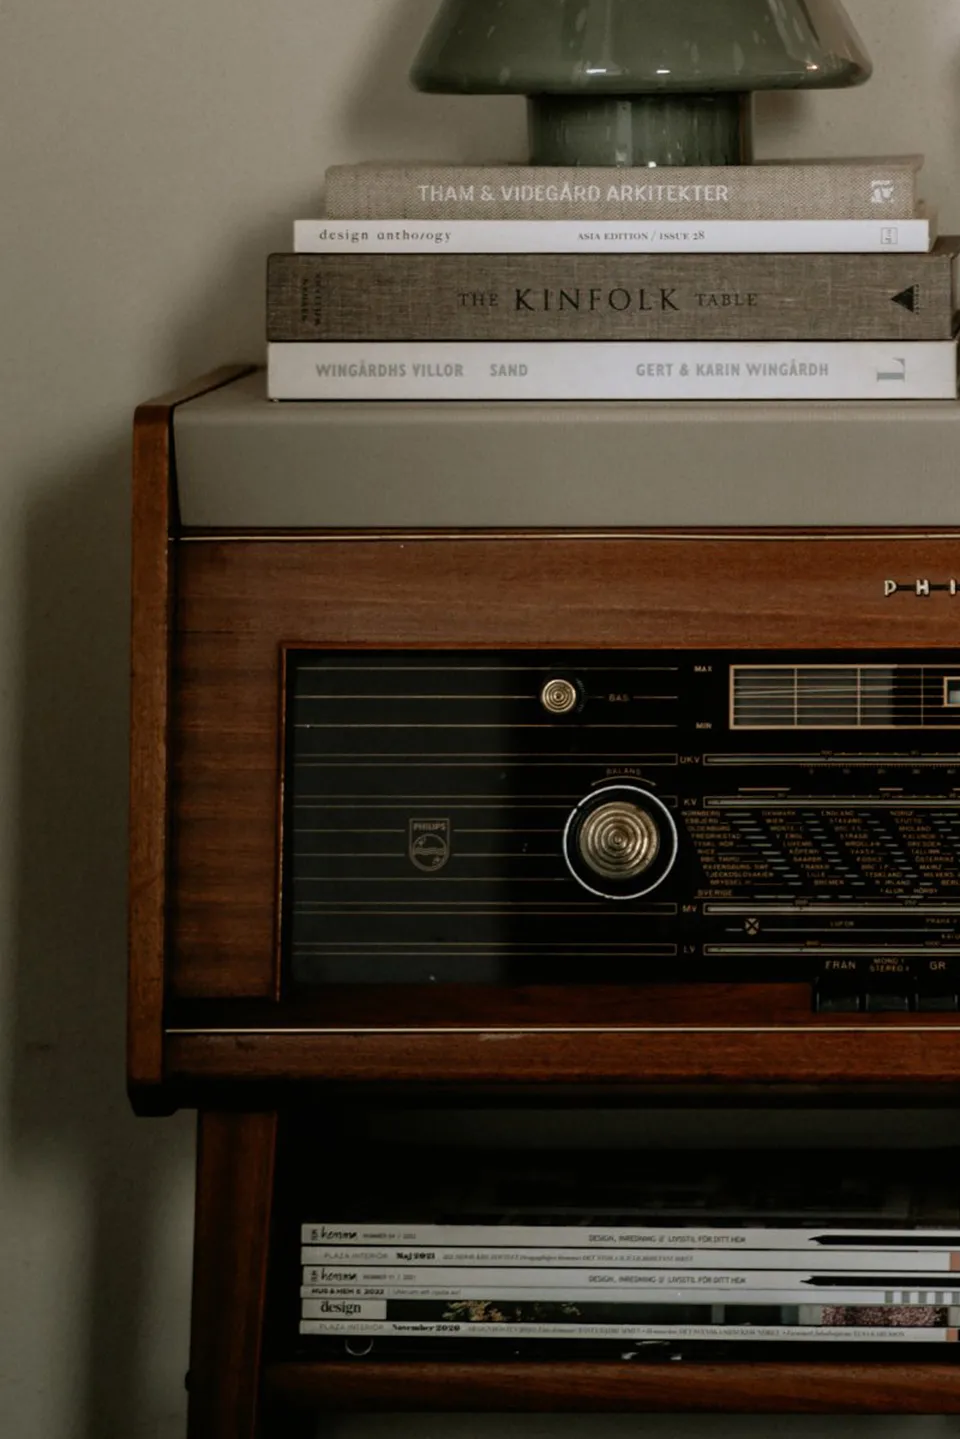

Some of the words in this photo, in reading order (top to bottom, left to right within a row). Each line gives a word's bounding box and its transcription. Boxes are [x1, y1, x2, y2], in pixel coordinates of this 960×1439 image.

[418, 185, 474, 202] THAM
[480, 185, 495, 201] &
[501, 182, 601, 202] VIDEGÅRD
[606, 185, 730, 202] ARKITEKTER
[319, 229, 369, 242] design
[577, 232, 601, 241] ASIA
[604, 232, 649, 241] EDITION
[659, 232, 690, 241] ISSUE
[692, 231, 706, 242] 28
[457, 291, 500, 307] THE
[515, 287, 681, 311] KINFOLK
[695, 292, 758, 308] TABLE
[316, 359, 407, 377] WINGÅRDHS
[412, 364, 464, 377] VILLOR
[489, 364, 528, 377] SAND
[636, 363, 673, 377] GERT
[679, 363, 690, 377] &
[696, 363, 741, 377] KARIN
[745, 359, 830, 377] WINGÅRDH
[680, 755, 700, 764] UKV
[683, 798, 697, 806] KV
[683, 904, 697, 913] MV
[684, 944, 696, 953] LV
[929, 960, 947, 970] GR
[321, 1226, 357, 1239] hemma
[321, 1267, 357, 1280] hemma
